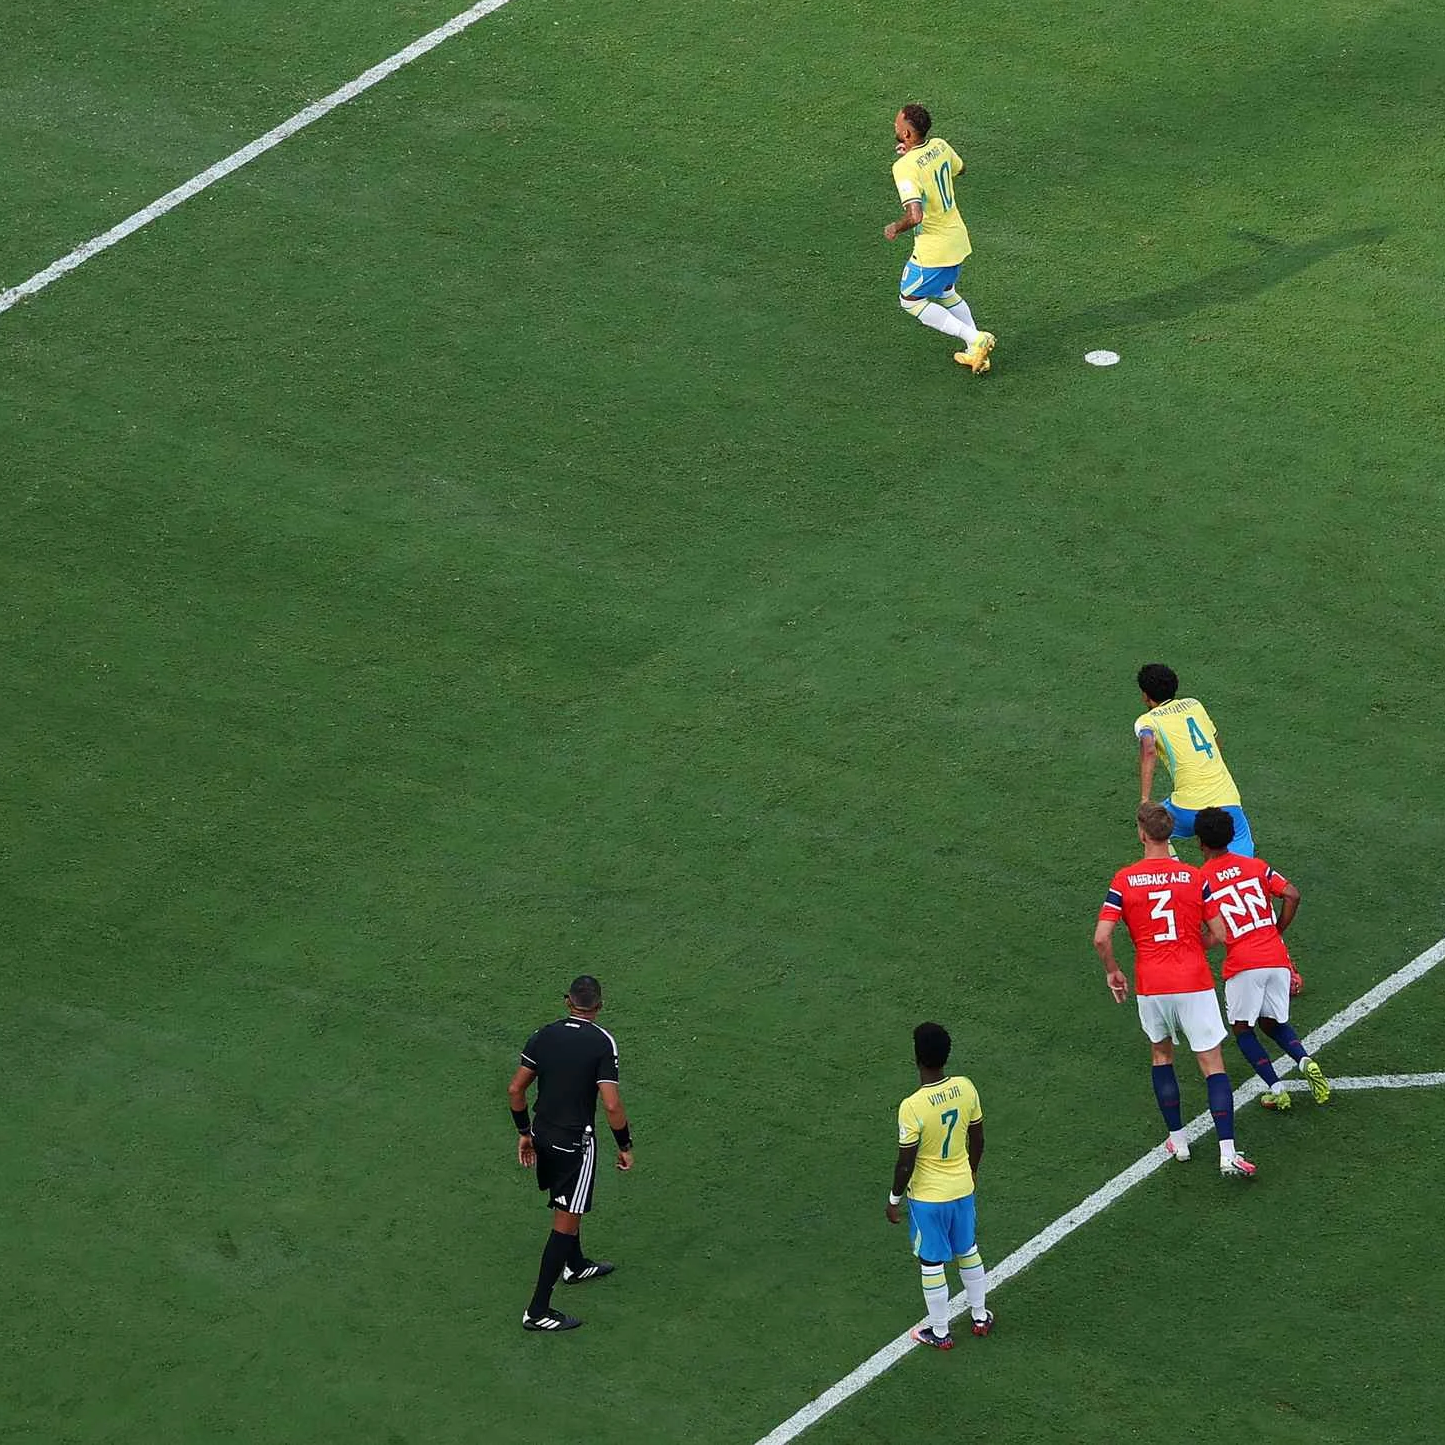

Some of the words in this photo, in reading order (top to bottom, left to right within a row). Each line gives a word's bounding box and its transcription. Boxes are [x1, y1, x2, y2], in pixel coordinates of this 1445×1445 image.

[934, 160, 953, 213] 10
[1186, 716, 1214, 760] 4
[1147, 889, 1179, 943] 3
[1210, 876, 1273, 940] 22
[940, 1107, 959, 1160] 7
